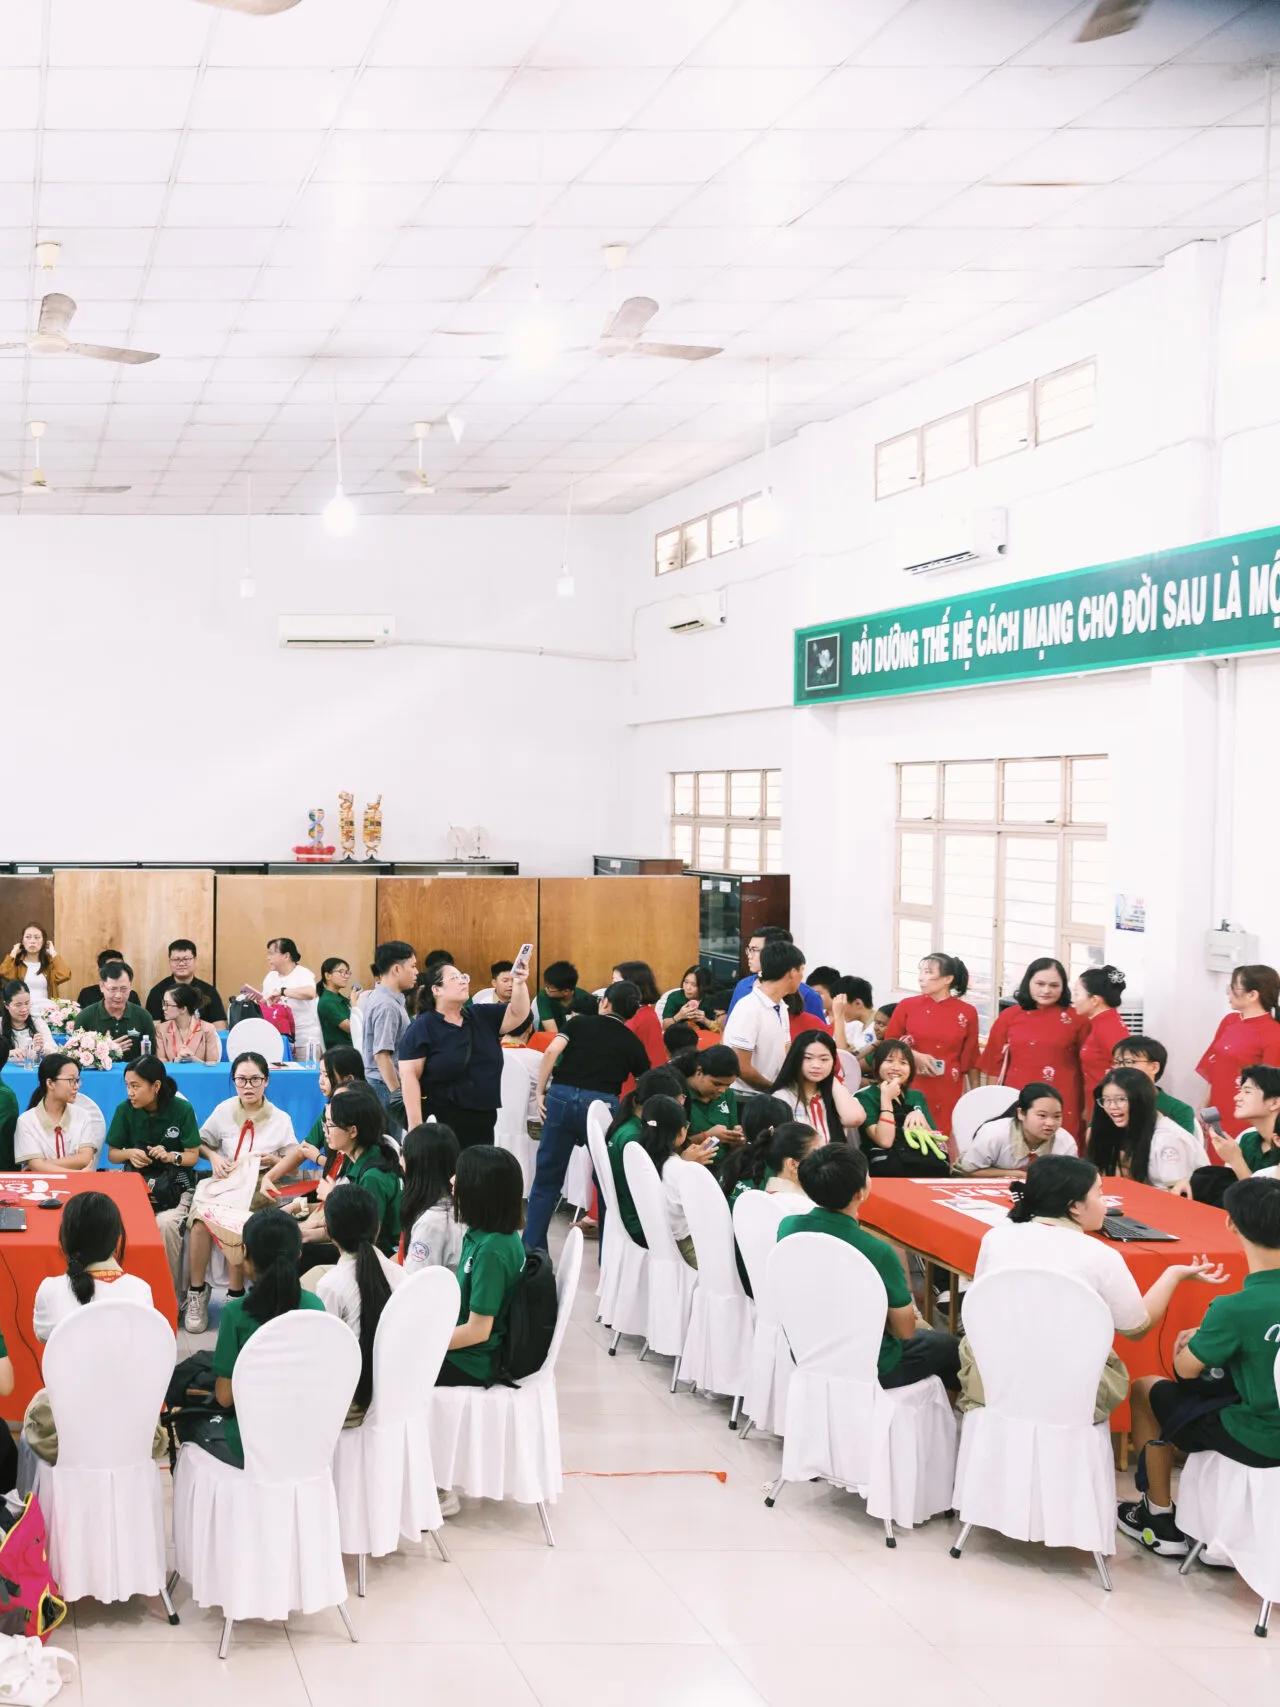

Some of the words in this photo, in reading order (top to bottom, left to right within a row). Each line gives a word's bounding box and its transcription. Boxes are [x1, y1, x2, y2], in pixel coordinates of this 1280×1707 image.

[851, 624, 872, 676] BỒI
[874, 622, 919, 673] DƯỠNG
[922, 606, 951, 665] THẾ
[952, 610, 974, 671] HỆ
[975, 603, 1020, 657] CÁCH
[1022, 600, 1074, 661] MẠNG
[1077, 591, 1118, 642] CHO
[1122, 573, 1158, 635] ĐỜI
[1162, 575, 1208, 630] SAU
[1212, 555, 1242, 622] LÀ
